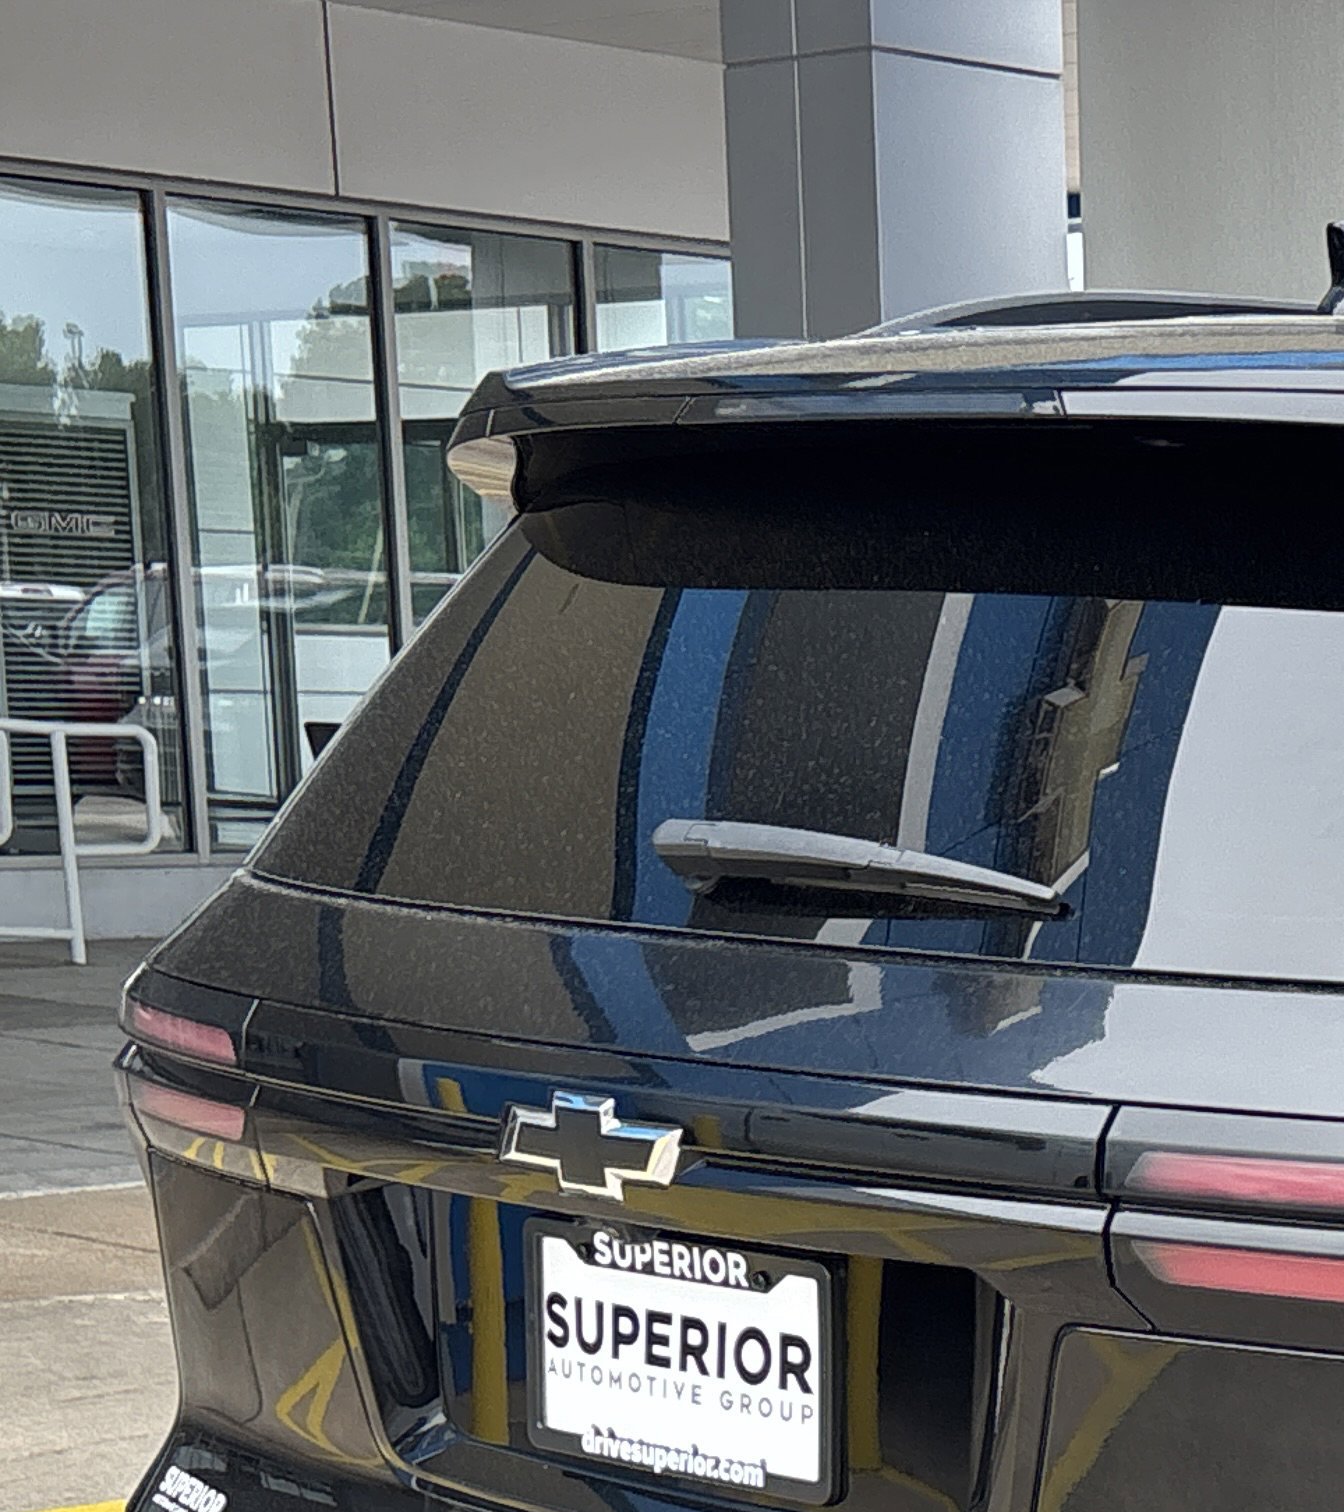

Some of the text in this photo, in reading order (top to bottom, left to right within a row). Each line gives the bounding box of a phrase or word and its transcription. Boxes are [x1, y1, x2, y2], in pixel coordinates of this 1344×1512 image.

[10, 510, 116, 537] GMC
[592, 1231, 749, 1288] SUPERIOR
[546, 1291, 813, 1395] SUPERIOR
[547, 1357, 814, 1425] AUTOMOTIVE GROUP
[581, 1431, 766, 1488] drivesuperior.com
